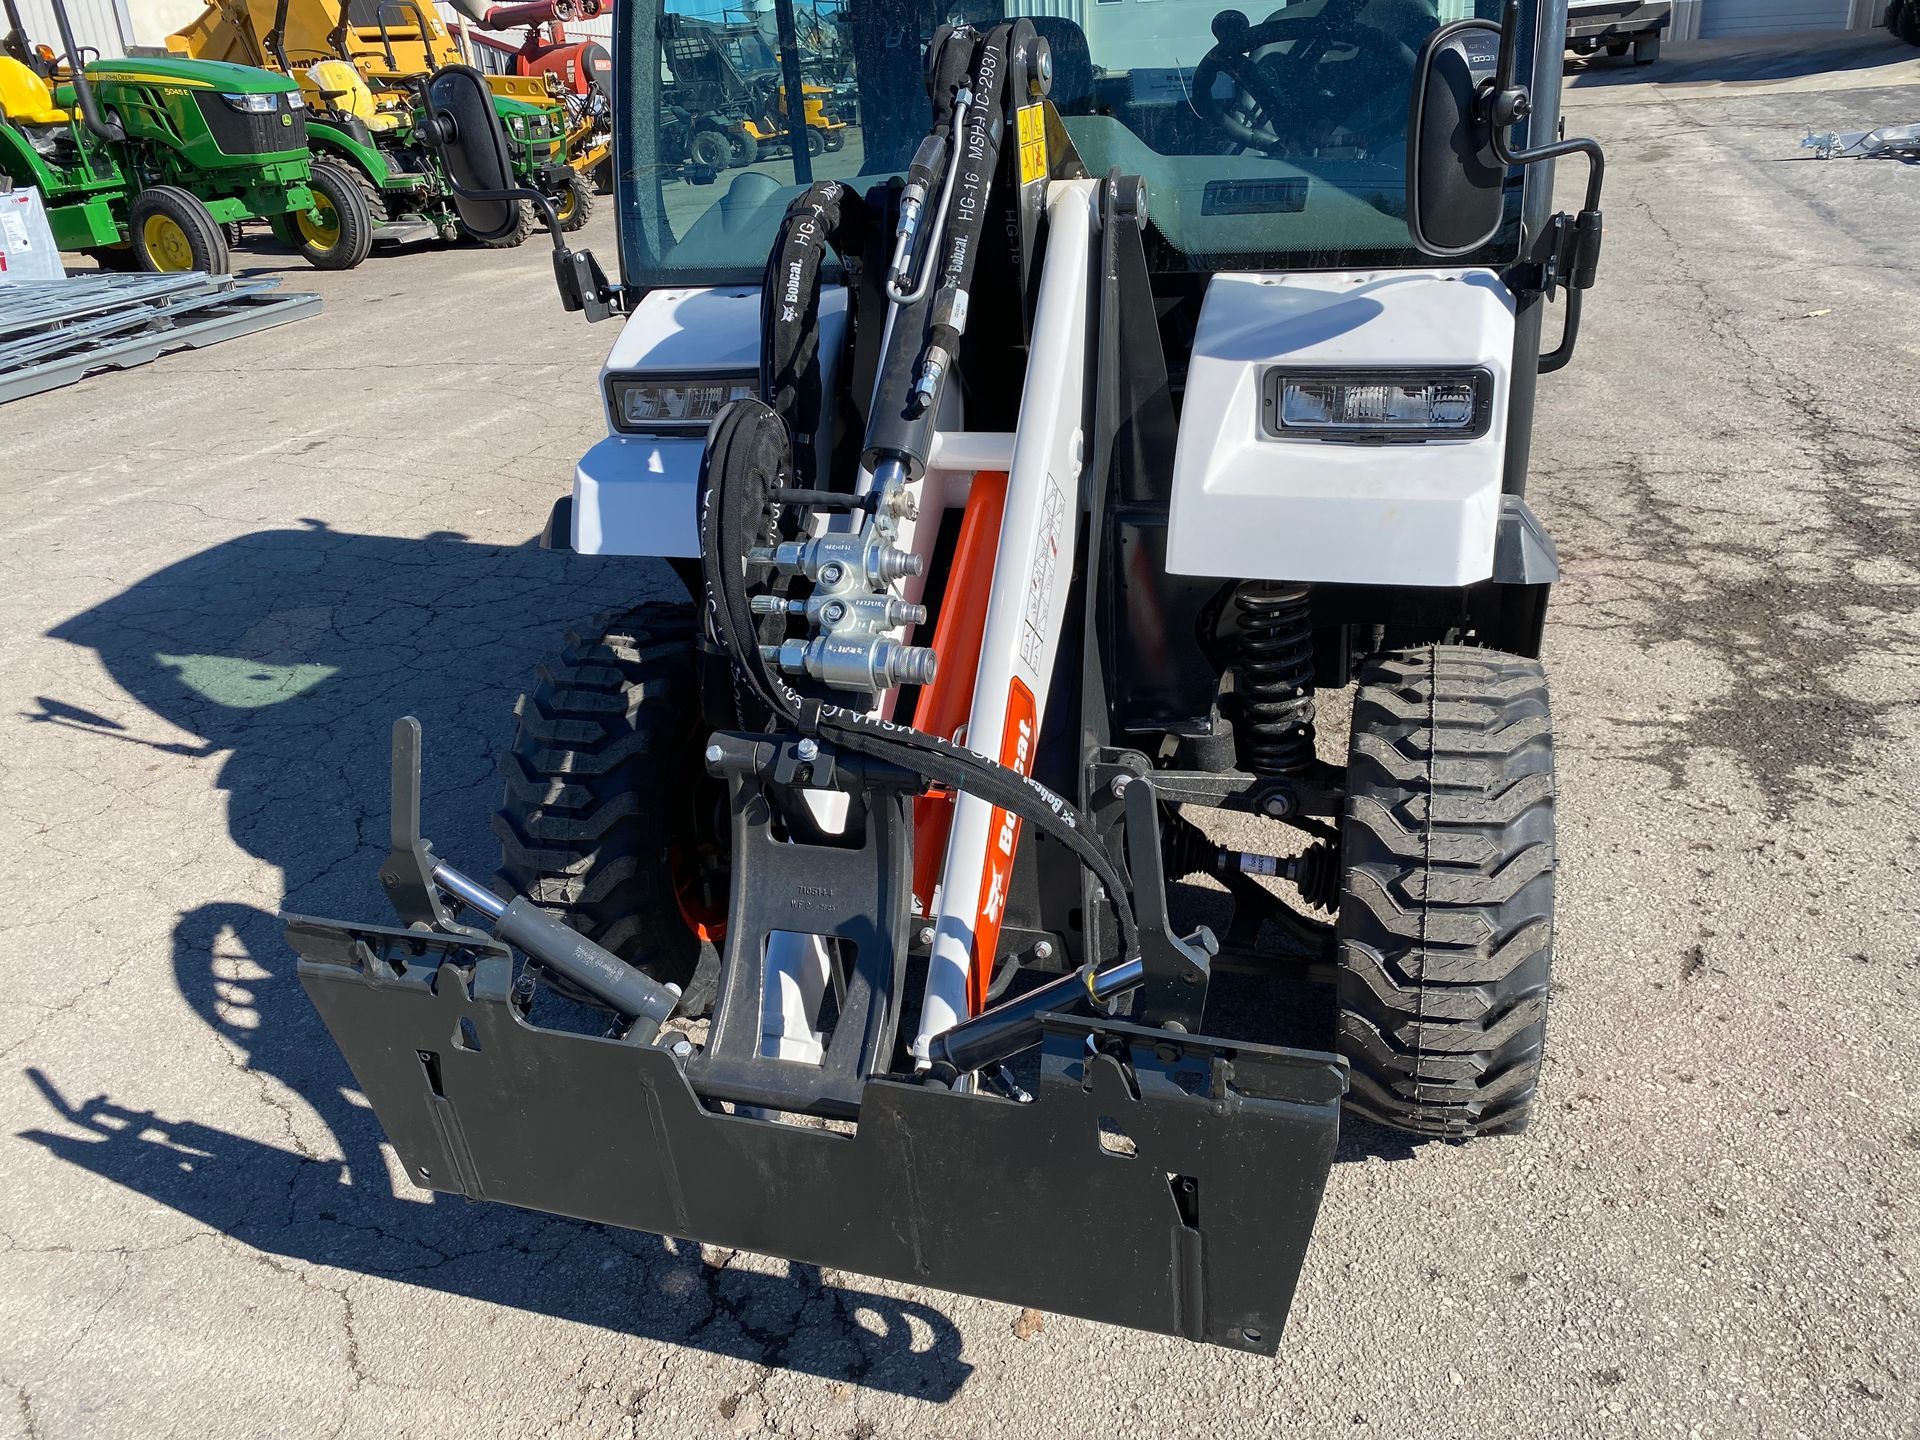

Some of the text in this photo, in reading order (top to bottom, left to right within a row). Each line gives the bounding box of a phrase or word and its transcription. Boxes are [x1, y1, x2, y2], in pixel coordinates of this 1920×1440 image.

[957, 171, 980, 221] HG-16
[947, 235, 969, 273] Bobcat
[785, 258, 804, 303] Bobcat
[998, 719, 1031, 857] Bocat
